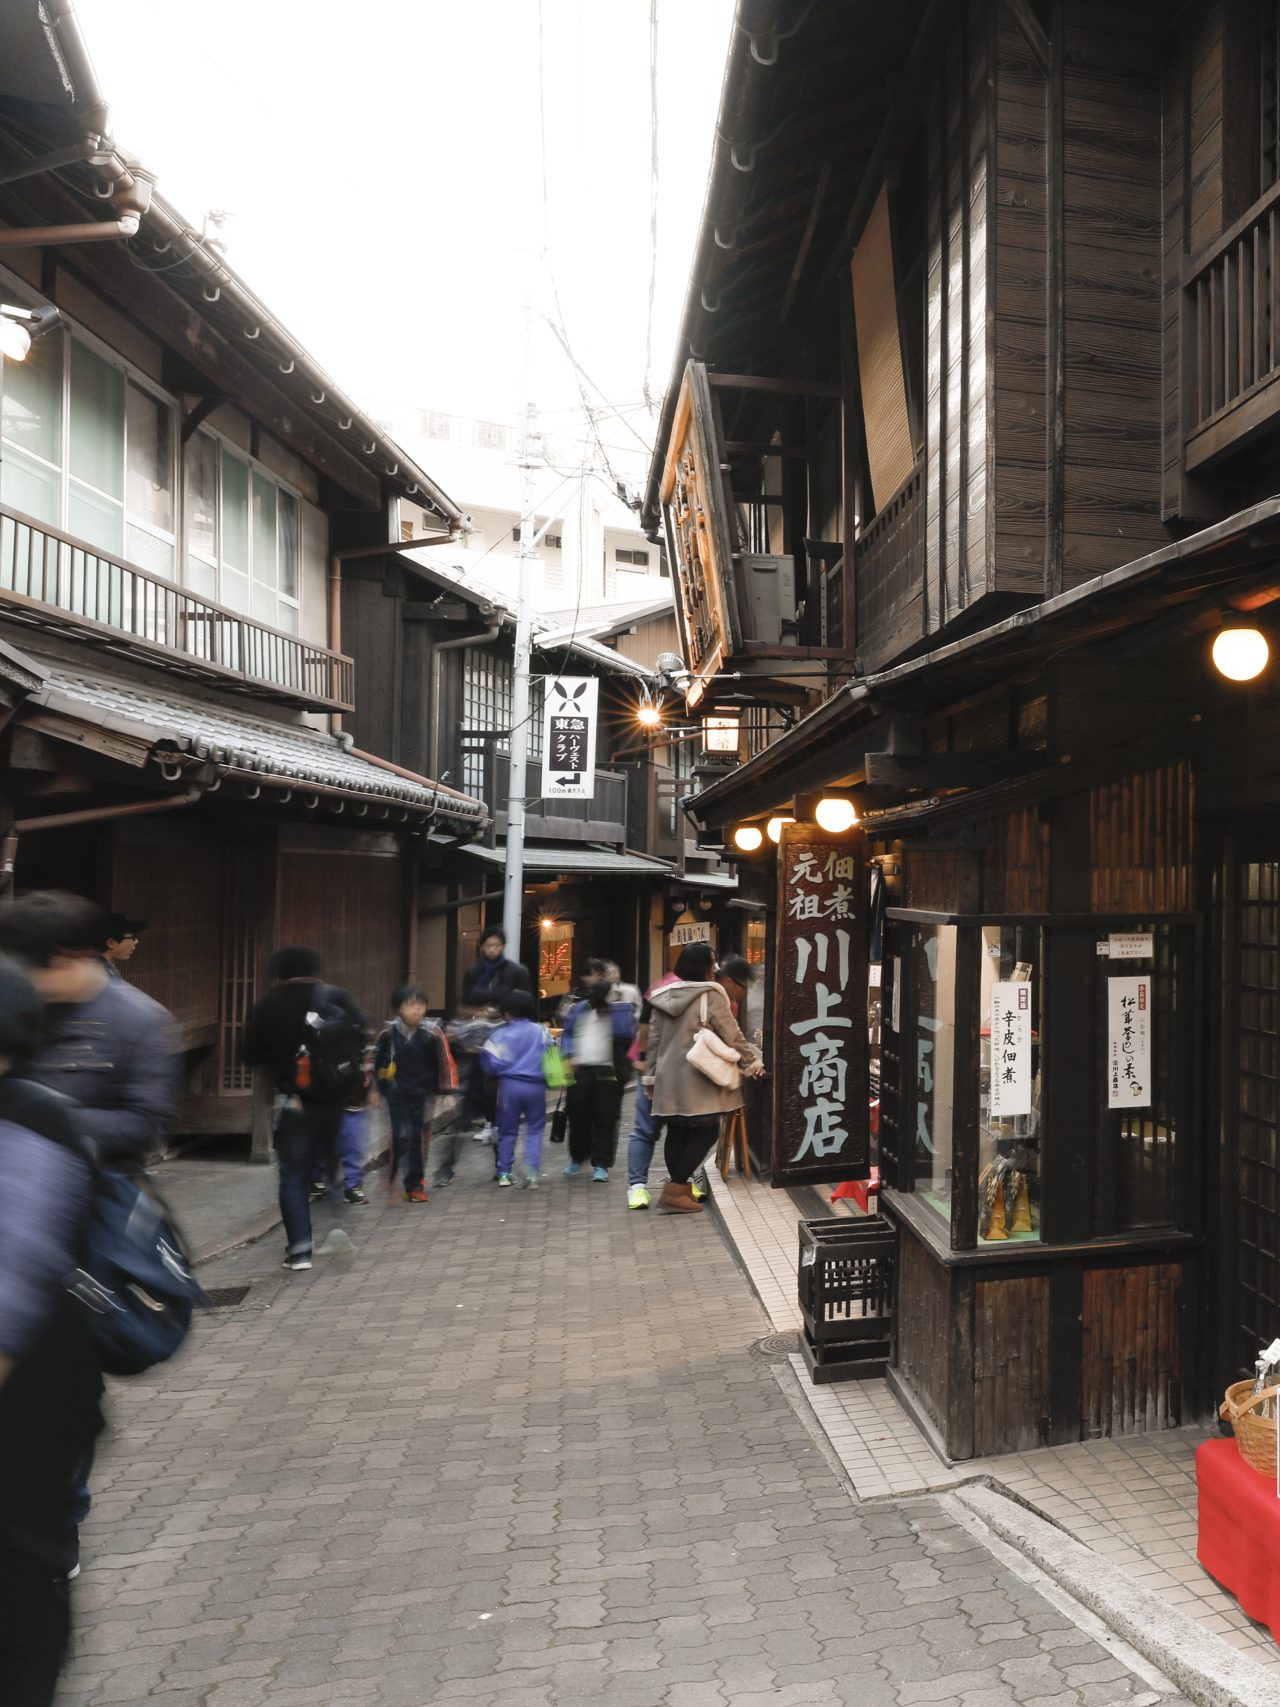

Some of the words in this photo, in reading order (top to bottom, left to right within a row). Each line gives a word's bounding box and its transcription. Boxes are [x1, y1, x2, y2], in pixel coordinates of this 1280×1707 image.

[554, 718, 585, 731] 東急
[555, 734, 568, 762] クラブ
[788, 852, 823, 922] 元祖
[823, 851, 856, 922] 佃煮
[789, 928, 853, 1164] 川上商店
[1002, 1010, 1017, 1085] 辛皮佃煮
